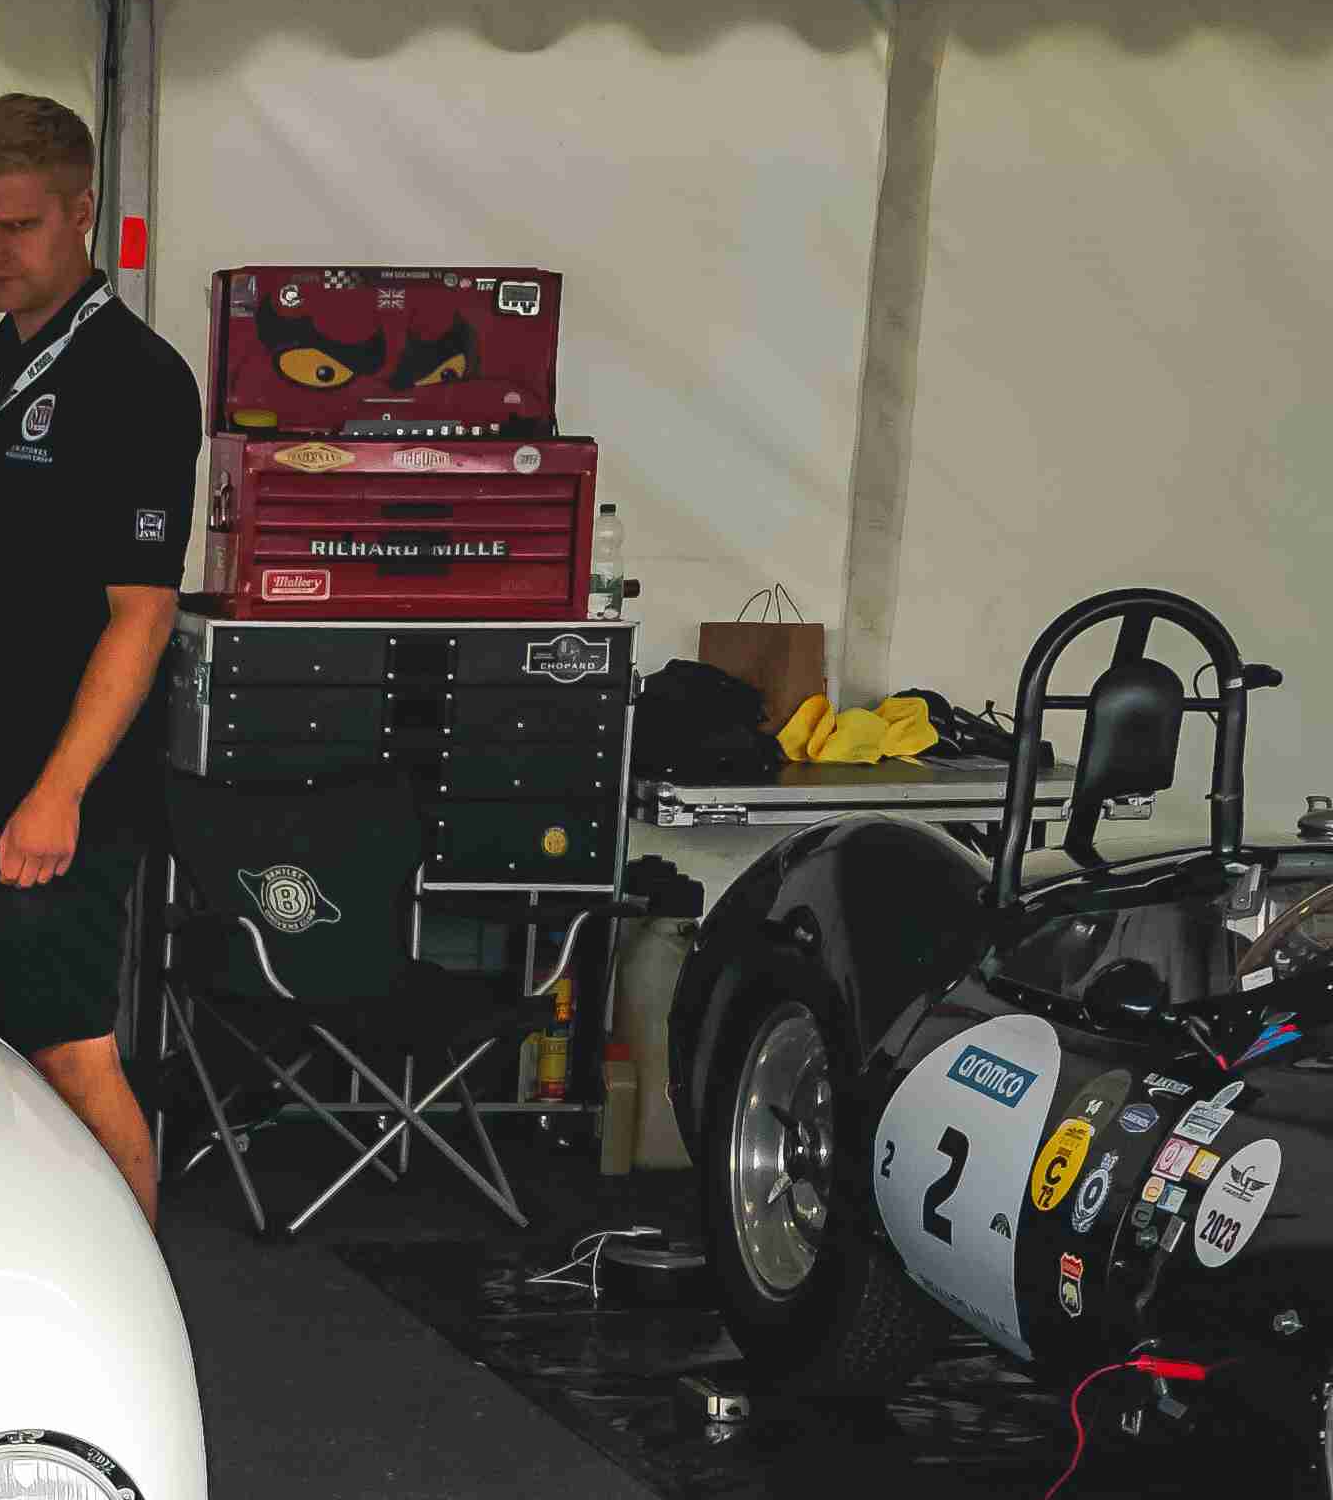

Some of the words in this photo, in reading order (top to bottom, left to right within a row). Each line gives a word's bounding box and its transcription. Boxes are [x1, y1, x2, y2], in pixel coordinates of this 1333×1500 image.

[433, 540, 509, 557] MILLE
[958, 1054, 1024, 1098] aramco
[881, 1140, 896, 1178] 2
[1045, 1156, 1067, 1184] C
[922, 1125, 970, 1246] 2
[1199, 1209, 1241, 1253] 2023
